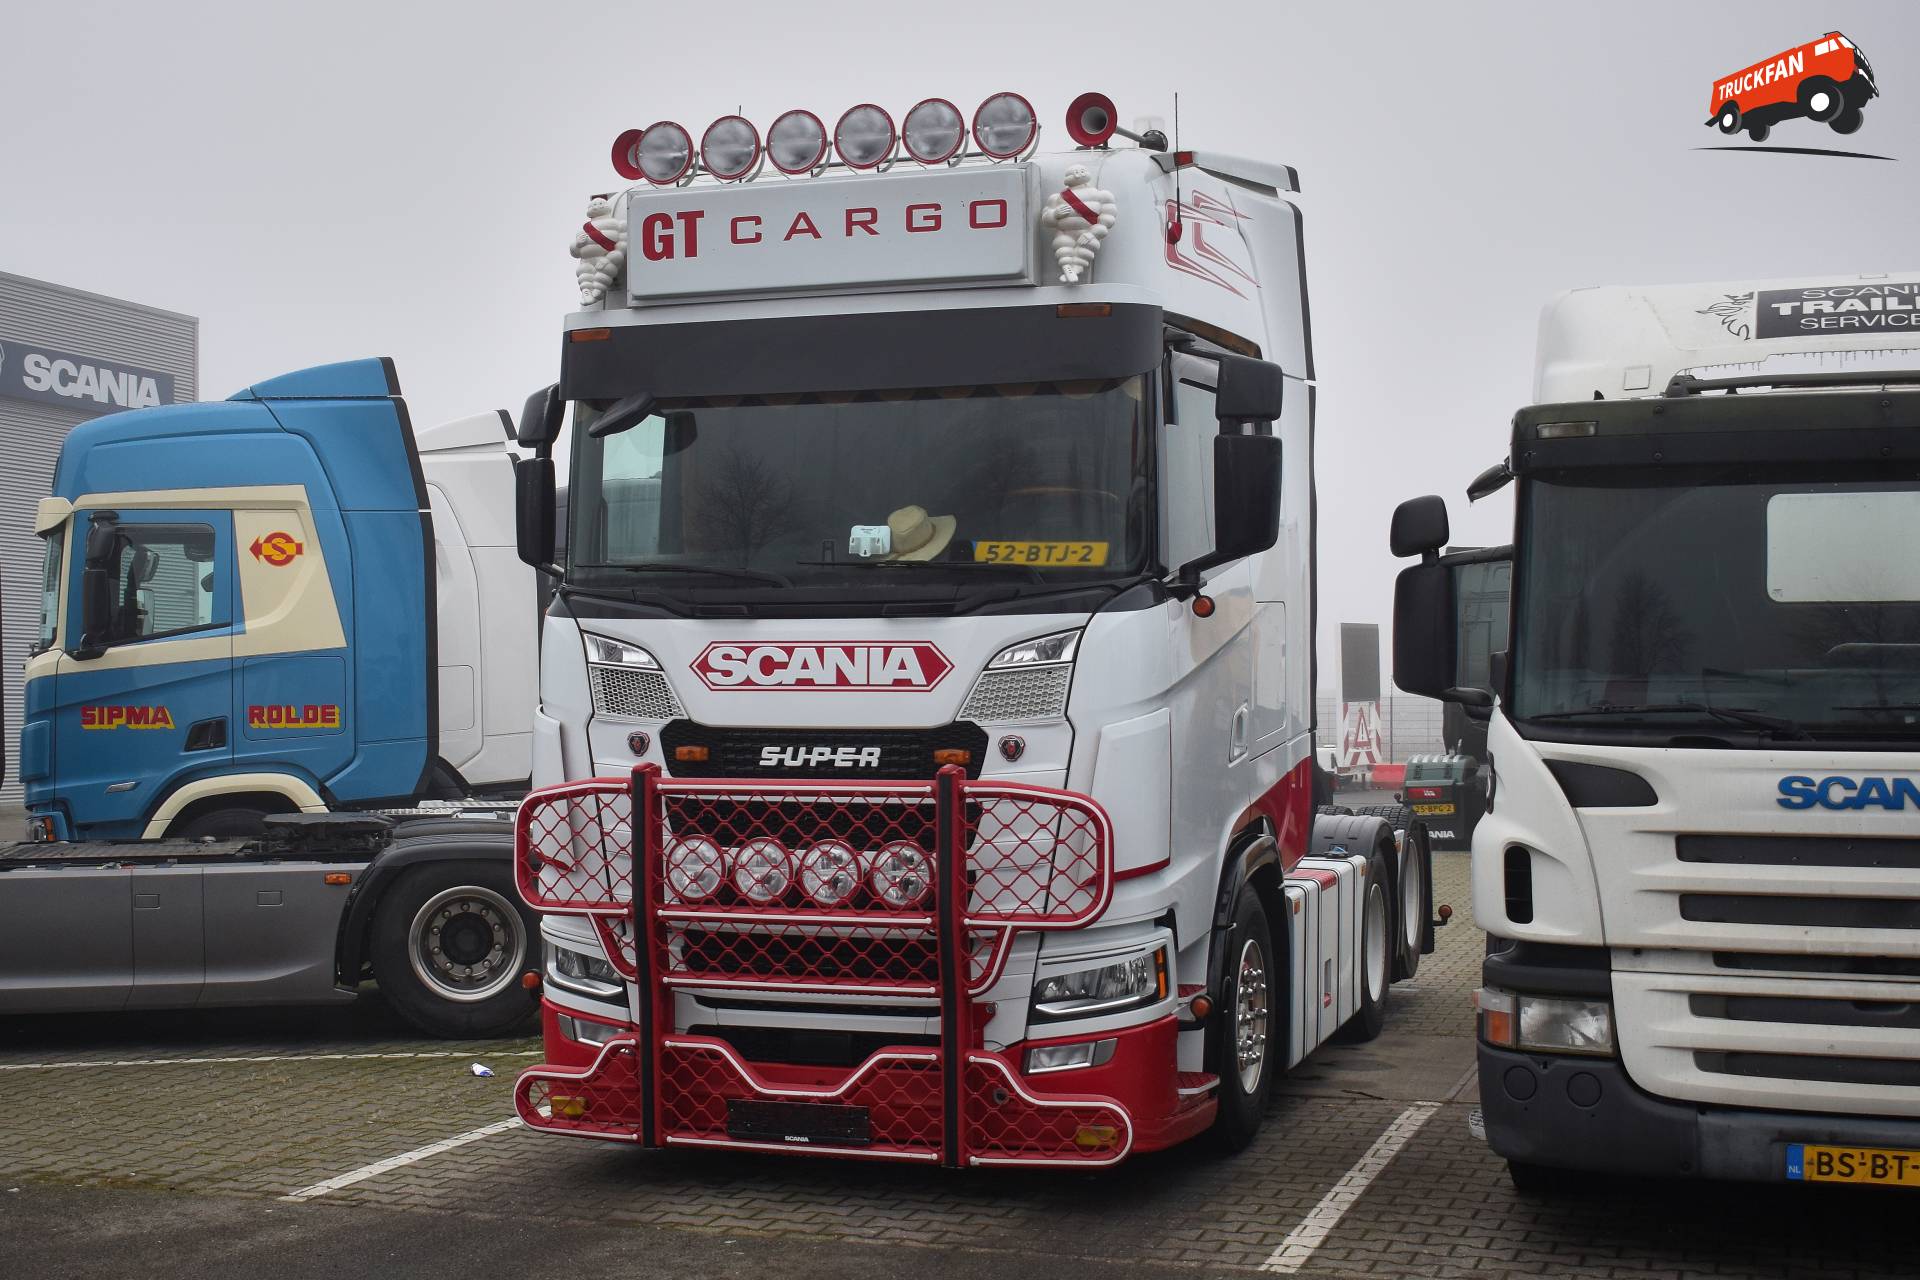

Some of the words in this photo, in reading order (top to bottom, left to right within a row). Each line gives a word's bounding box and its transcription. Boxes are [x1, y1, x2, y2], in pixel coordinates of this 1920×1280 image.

[642, 210, 705, 261] GT
[730, 199, 1008, 245] CARGO
[1771, 295, 1920, 316] TRAIL
[23, 353, 161, 409] SCANIA
[985, 544, 1094, 563] 52-BTJ-2
[706, 646, 927, 686] SCANIA
[80, 704, 176, 730] SIPMA
[247, 704, 340, 729] ROLDE
[759, 747, 882, 768] SUPER
[1788, 1165, 1801, 1174] NL
